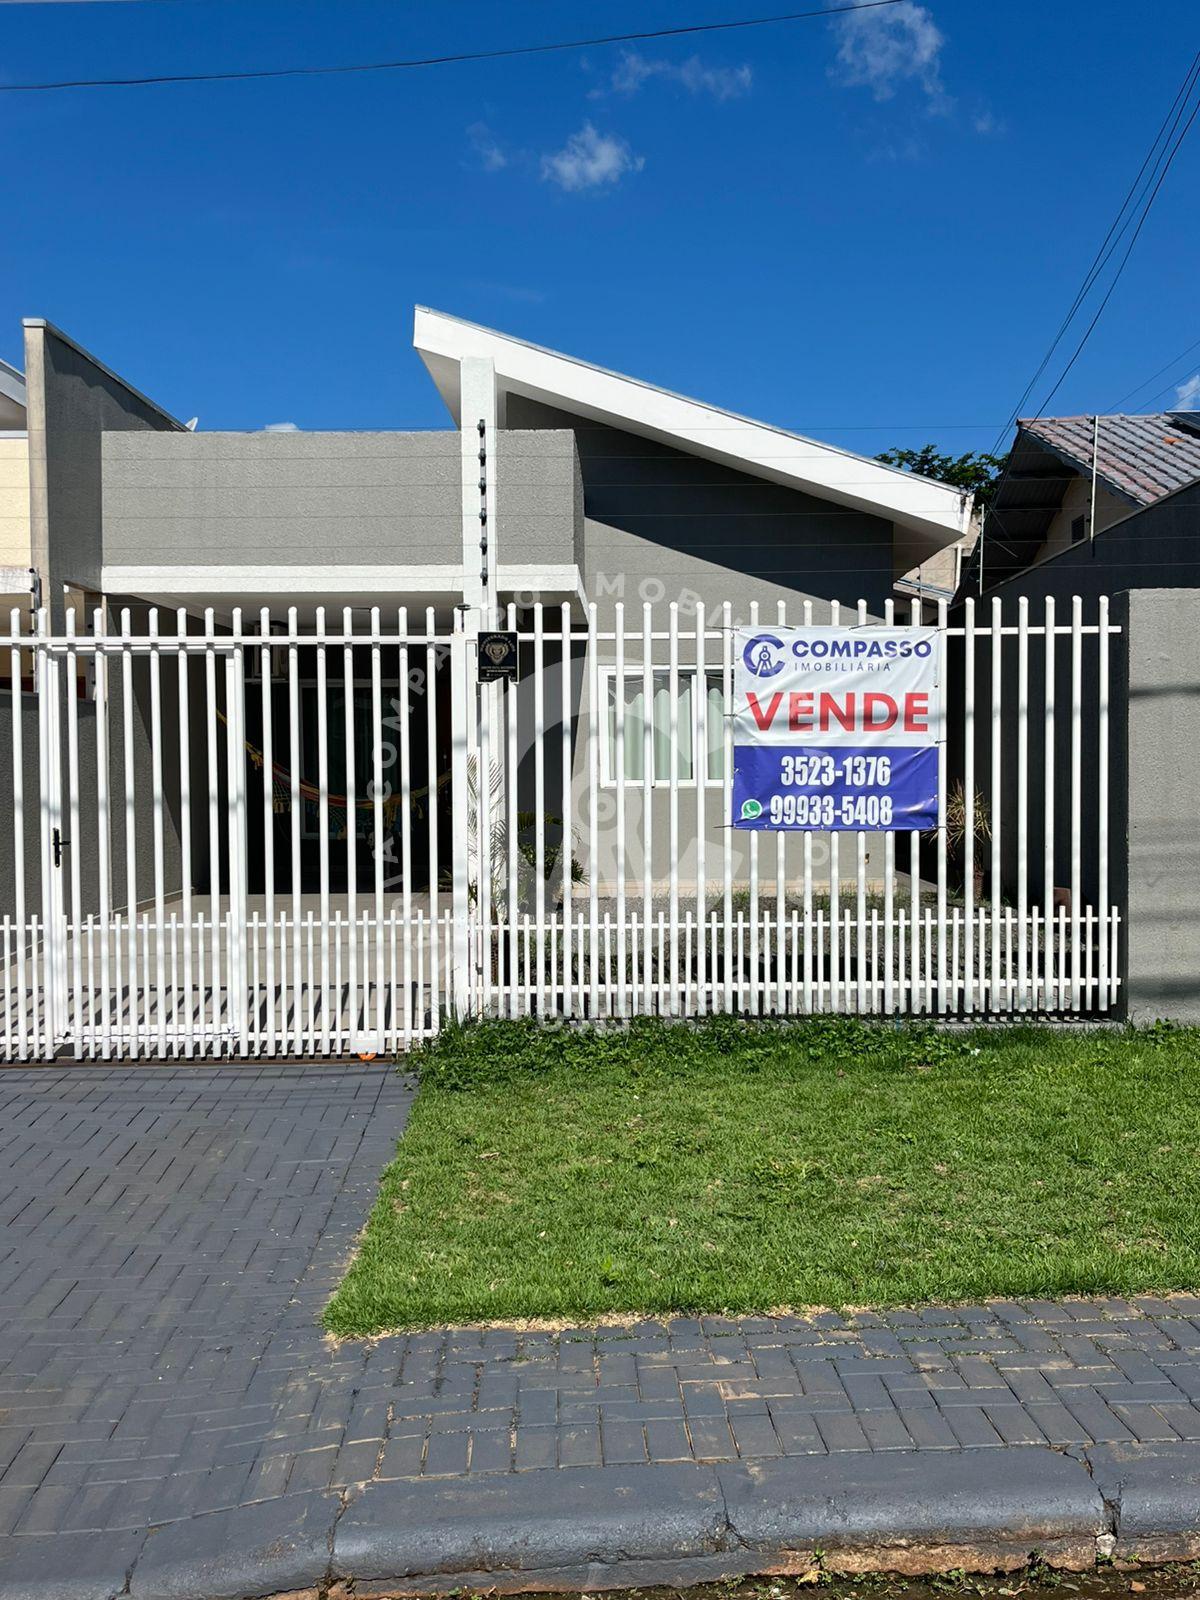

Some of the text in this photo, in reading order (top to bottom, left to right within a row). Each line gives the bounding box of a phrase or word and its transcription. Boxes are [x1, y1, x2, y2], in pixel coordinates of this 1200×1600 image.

[792, 640, 932, 658] COMPASSO
[794, 661, 891, 672] IMOBILIÁRIA
[745, 692, 929, 732] VENDE
[780, 755, 891, 786] 3523-1376
[770, 795, 893, 826] 99933-5408
